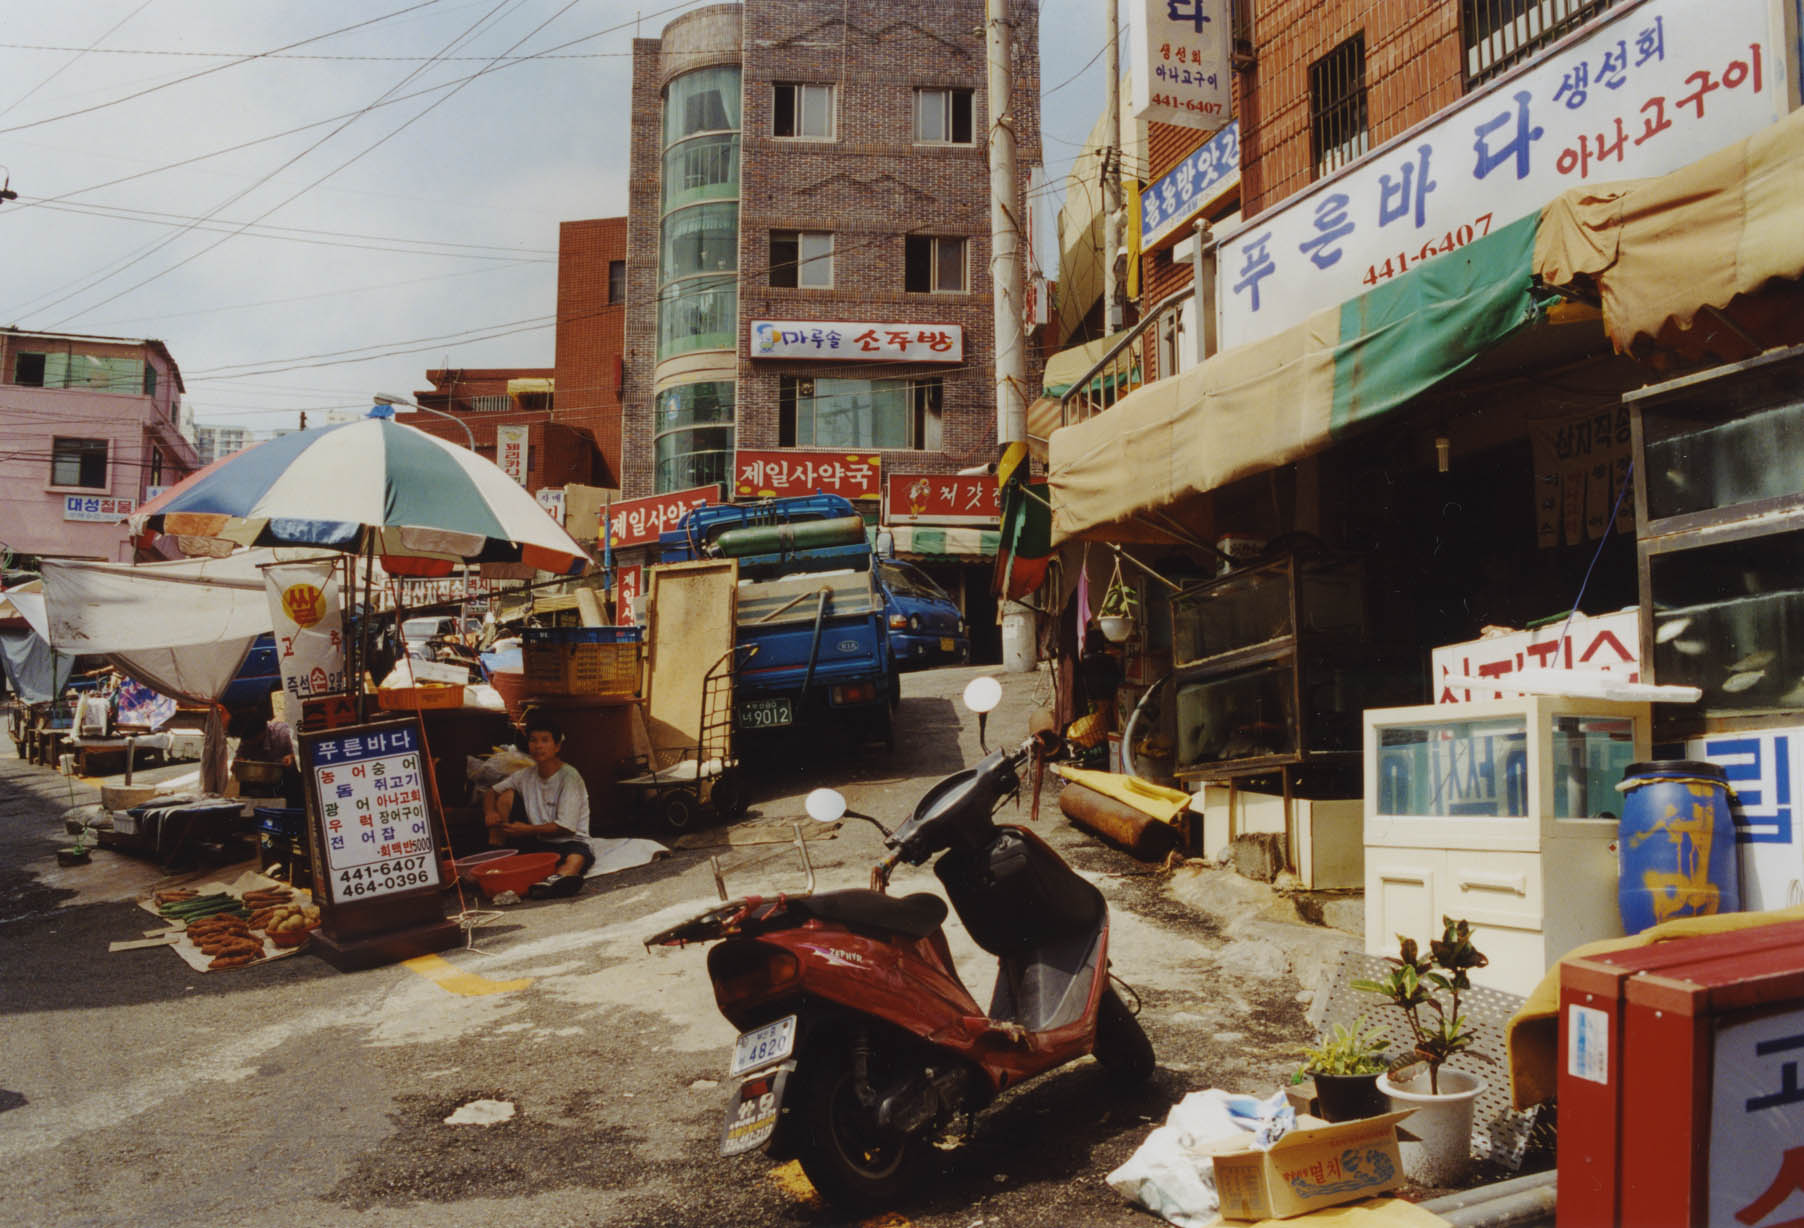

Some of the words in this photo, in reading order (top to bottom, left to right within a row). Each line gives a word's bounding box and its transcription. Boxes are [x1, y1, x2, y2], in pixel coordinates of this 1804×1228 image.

[1160, 43, 1201, 66] 생선회
[1553, 16, 1664, 109] 생선회
[1155, 64, 1218, 90] 아나고구이
[1152, 93, 1222, 115] 441-6407
[1556, 43, 1762, 179] 아나고구이
[1232, 90, 1543, 312] 푸른바다
[781, 329, 842, 349] 마루솔
[853, 329, 953, 352] 소주방
[740, 460, 872, 490] 제일사약국
[611, 498, 706, 540] 제일사약
[288, 586, 320, 625] 쌀
[754, 706, 789, 725] 9012
[318, 730, 410, 760] 푸른바다
[374, 773, 418, 791] 쥐고기
[377, 790, 421, 807] 아나고회
[380, 805, 423, 824] 장어구이
[340, 856, 426, 883] 441-6407
[343, 870, 429, 897] 464-0396
[829, 948, 863, 963] ZEPHYR
[749, 1036, 787, 1062] 4820
[1310, 1157, 1342, 1185] 멸치
